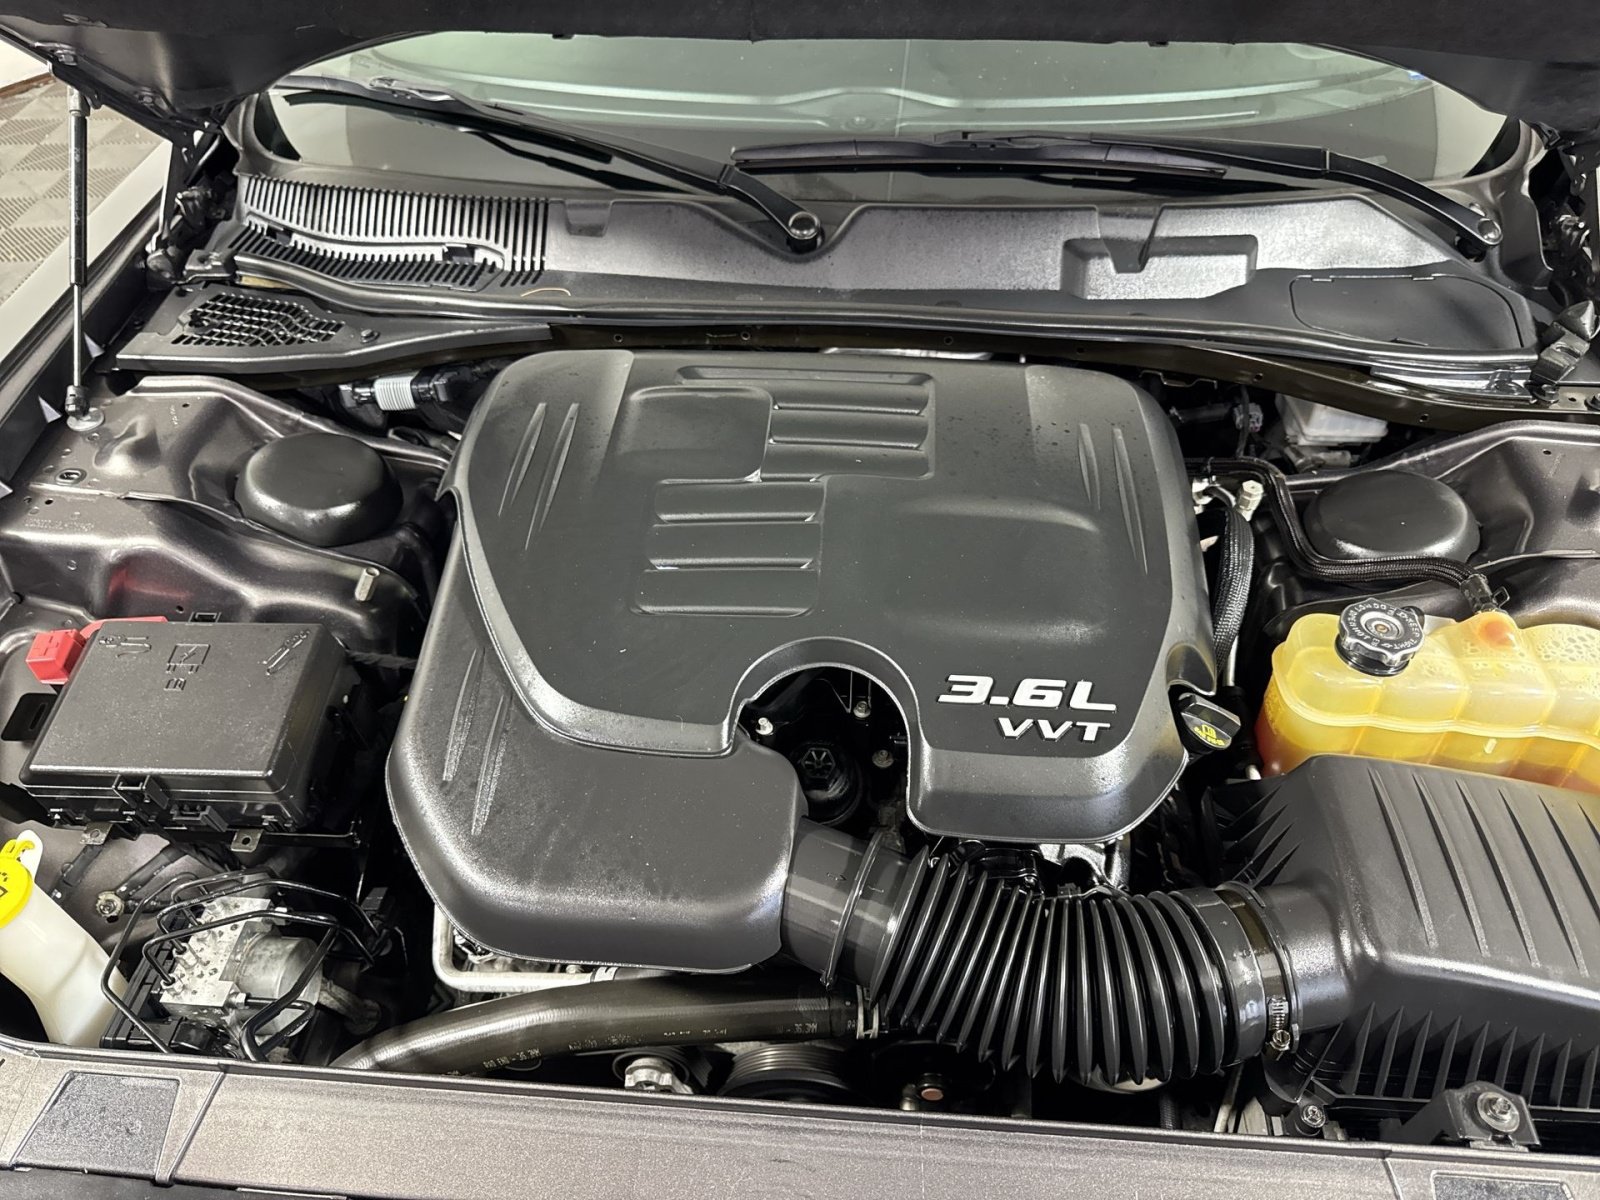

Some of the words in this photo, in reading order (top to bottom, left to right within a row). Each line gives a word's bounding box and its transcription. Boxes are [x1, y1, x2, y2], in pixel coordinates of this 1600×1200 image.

[1393, 638, 1418, 650] TIGHT
[938, 674, 1117, 712] 3.6L
[998, 717, 1111, 742] VVT
